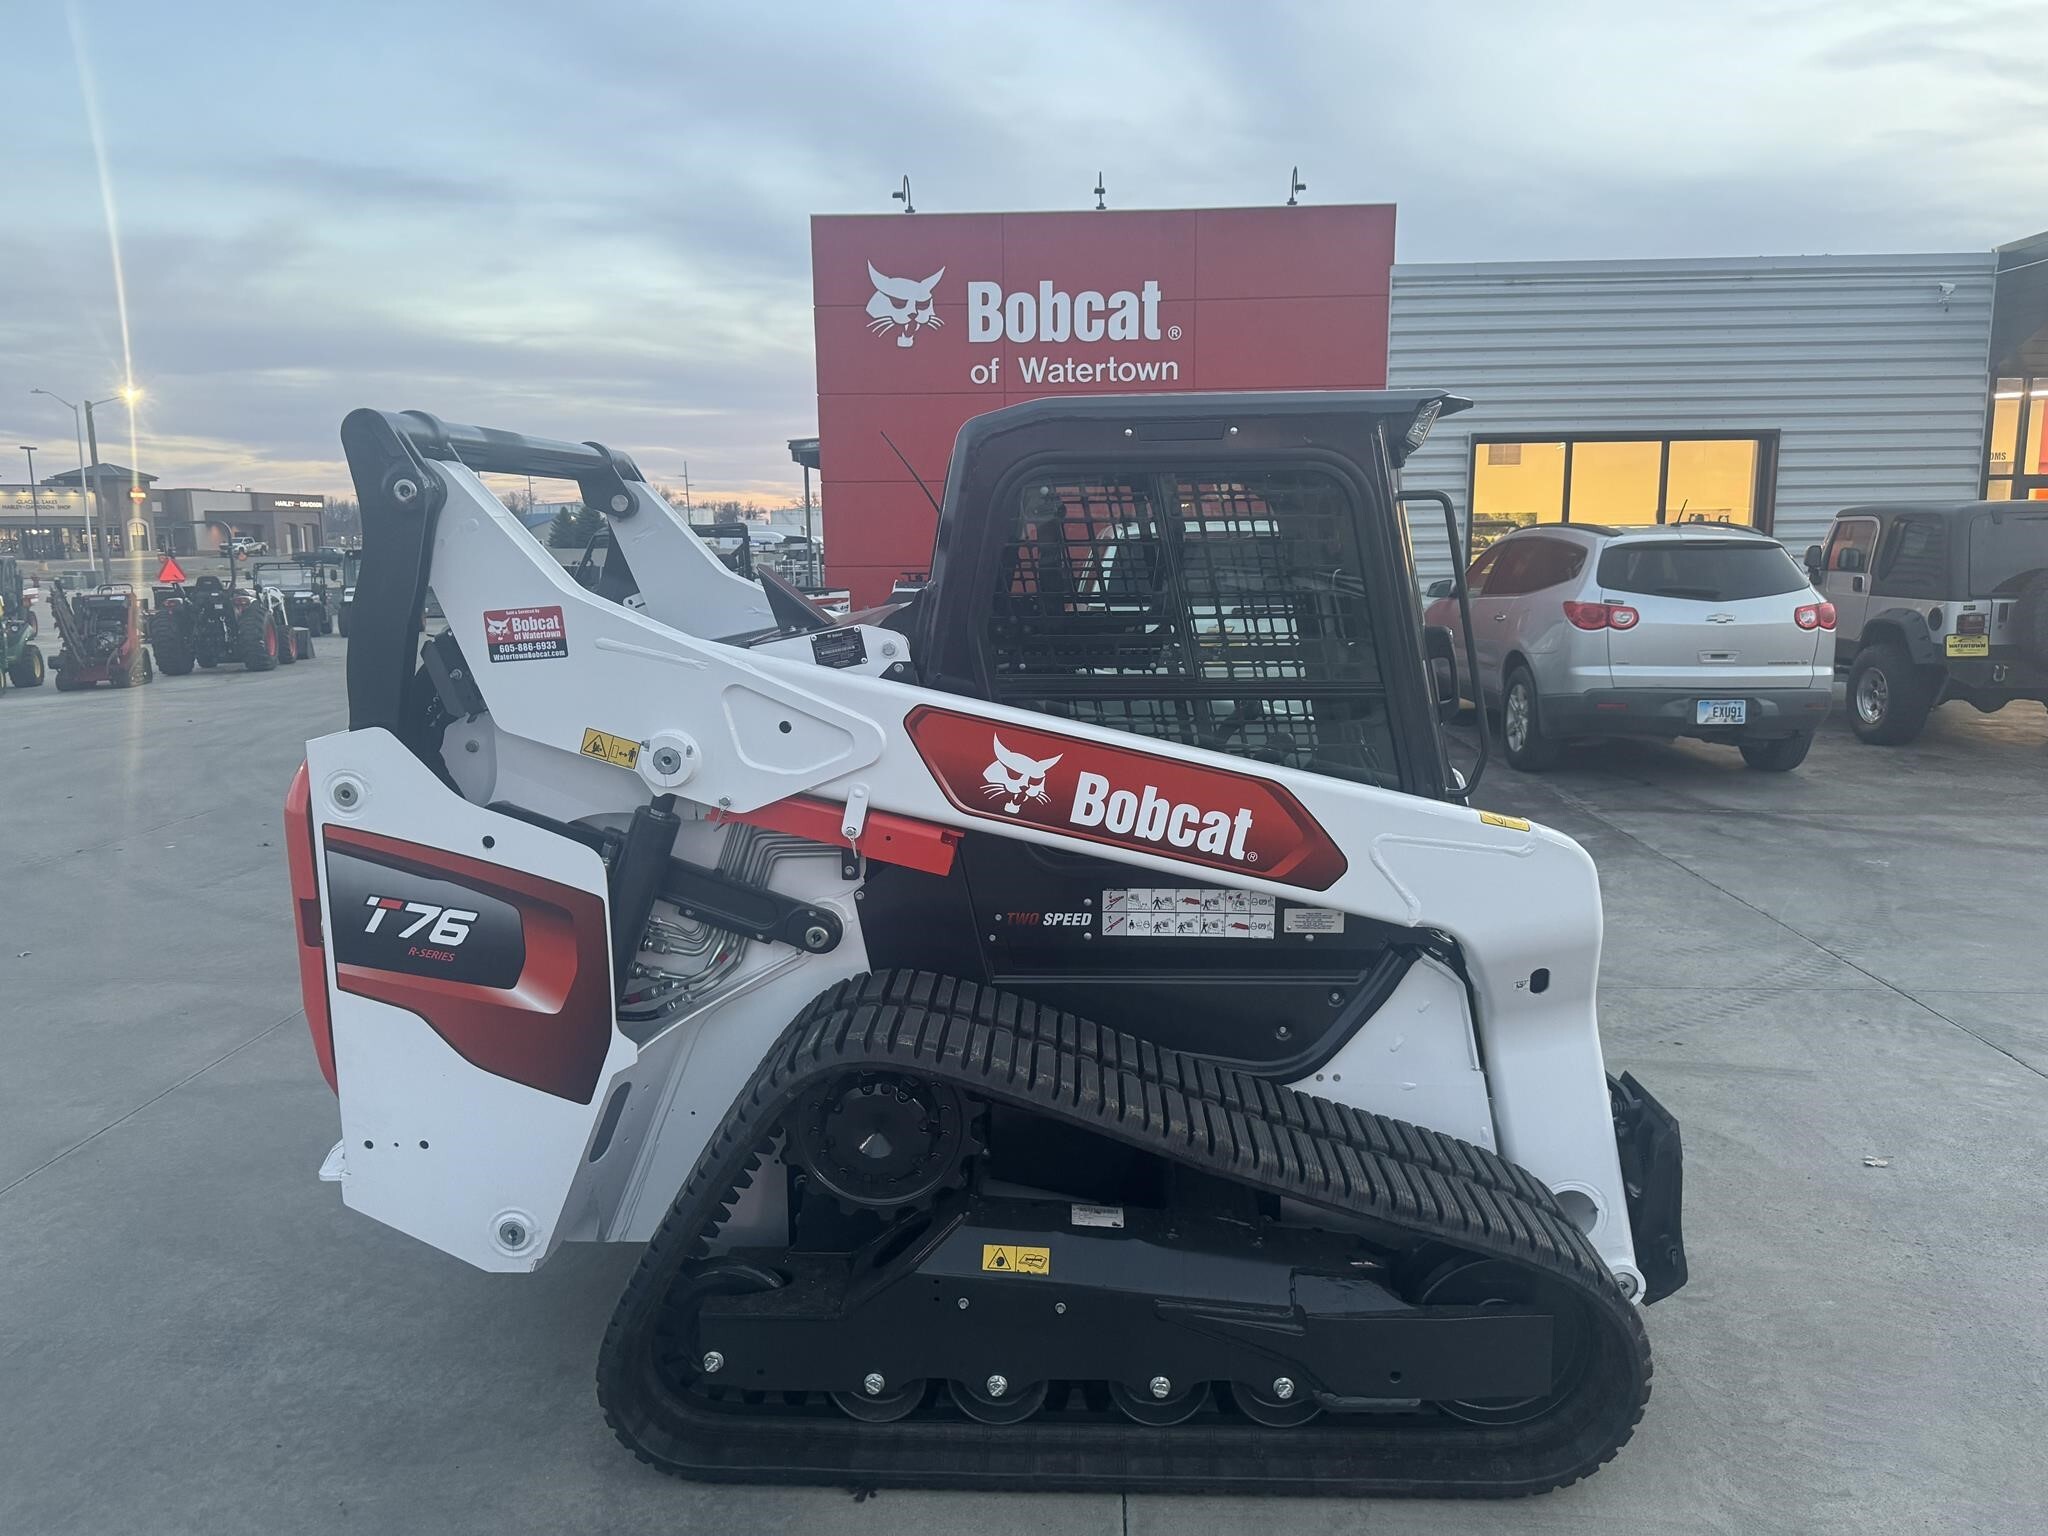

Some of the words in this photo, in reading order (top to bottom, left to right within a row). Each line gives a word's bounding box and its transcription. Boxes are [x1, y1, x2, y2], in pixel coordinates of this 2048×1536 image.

[967, 280, 1162, 343] Bobcat
[970, 357, 1000, 385] of
[1018, 356, 1179, 384] Watertown
[511, 615, 559, 632] Bobcat
[514, 632, 521, 640] of
[522, 630, 561, 640] Watertown
[500, 641, 557, 653] 605-886-6933
[493, 650, 566, 661] WatertownBobcat.com
[1712, 706, 1743, 718] EXU91
[1069, 770, 1253, 861] Bobcat
[364, 896, 478, 946] T76
[1007, 912, 1040, 926] TWO
[1042, 912, 1092, 926] SPEED
[408, 946, 455, 962] R-SERIES
